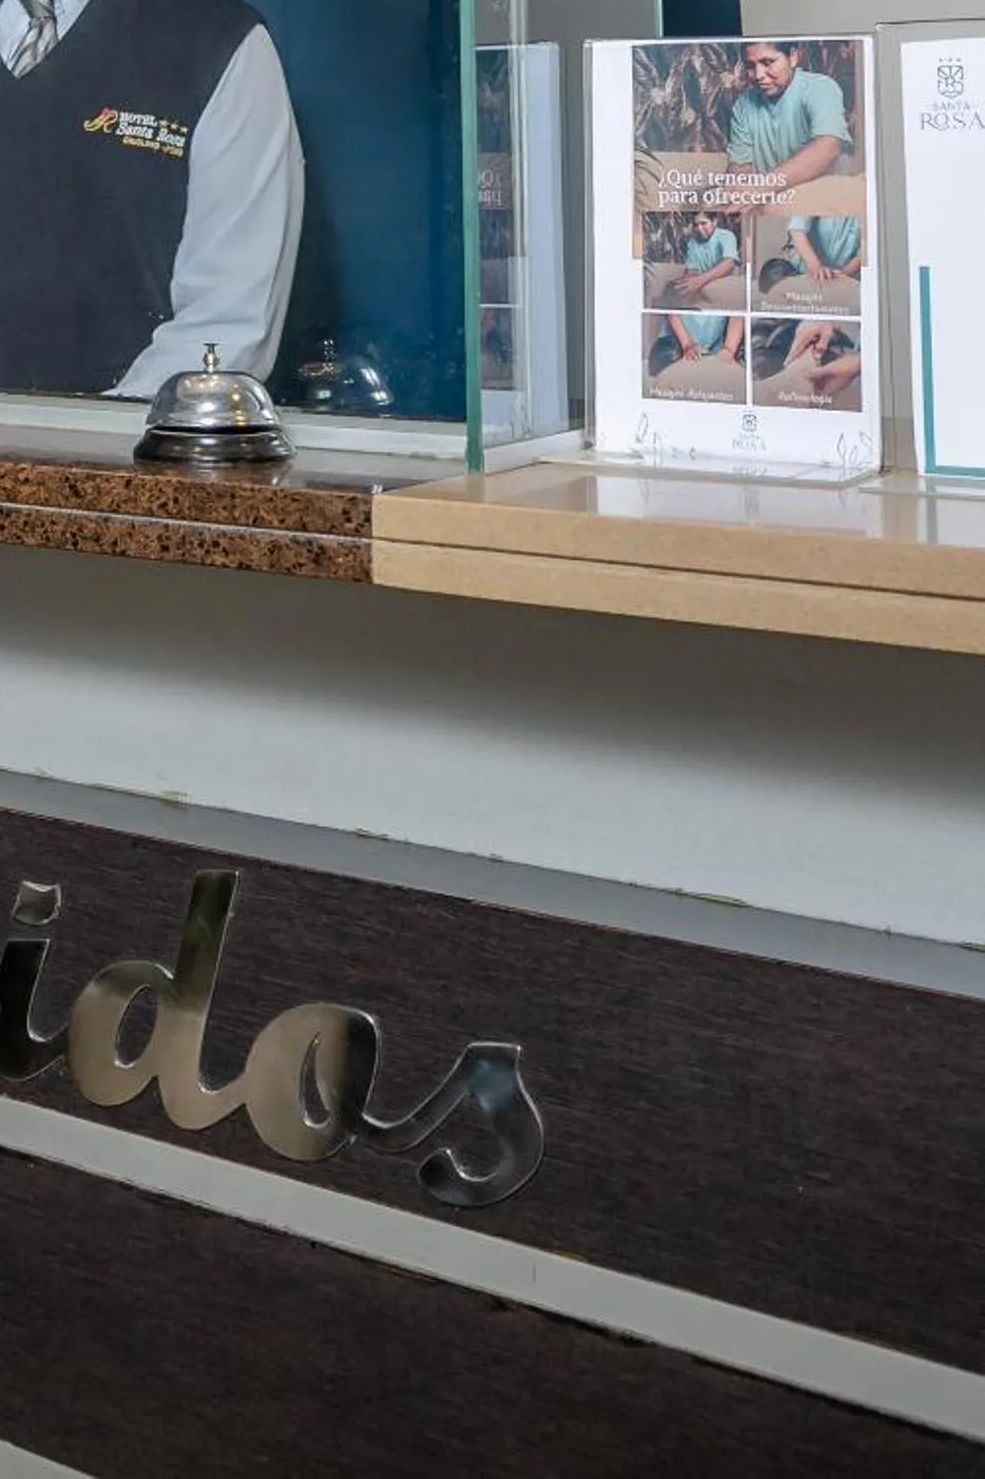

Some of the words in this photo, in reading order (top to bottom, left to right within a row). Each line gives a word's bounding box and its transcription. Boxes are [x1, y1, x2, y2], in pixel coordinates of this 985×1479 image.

[920, 112, 985, 131] ROSA
[707, 171, 787, 187] tenemos
[658, 190, 699, 208] para
